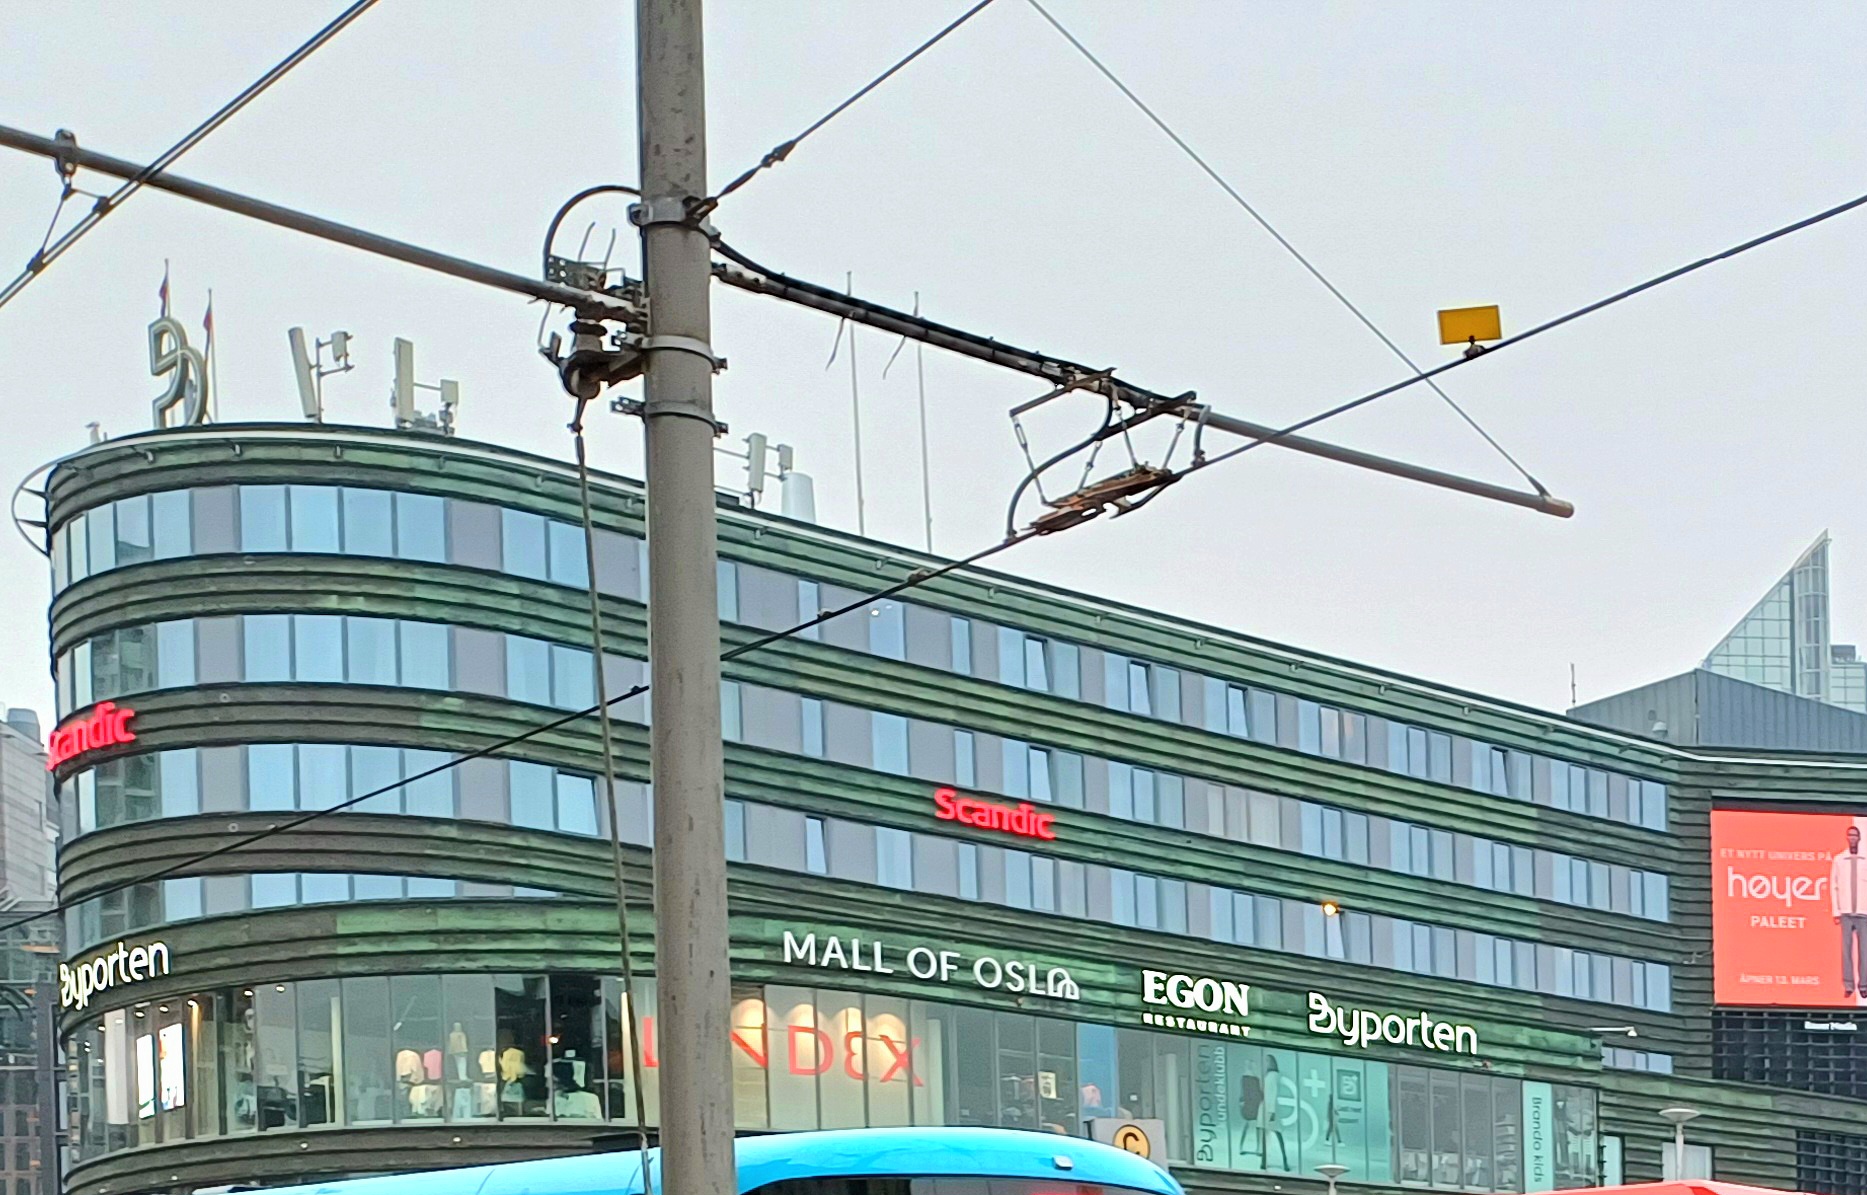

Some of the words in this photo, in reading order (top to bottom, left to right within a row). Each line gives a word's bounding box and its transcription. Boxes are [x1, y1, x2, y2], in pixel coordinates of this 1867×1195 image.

[933, 786, 1056, 841] Scandic
[1727, 866, 1828, 907] høyer
[1750, 915, 1807, 929] PALEET
[58, 941, 171, 1011] Byporten
[782, 931, 895, 975] MALL
[906, 947, 961, 982] OF
[1142, 969, 1250, 1017] EGON
[1142, 1012, 1251, 1037] RESTAURANT
[1307, 991, 1478, 1055] Byporten
[643, 1016, 924, 1087] LNDEX
